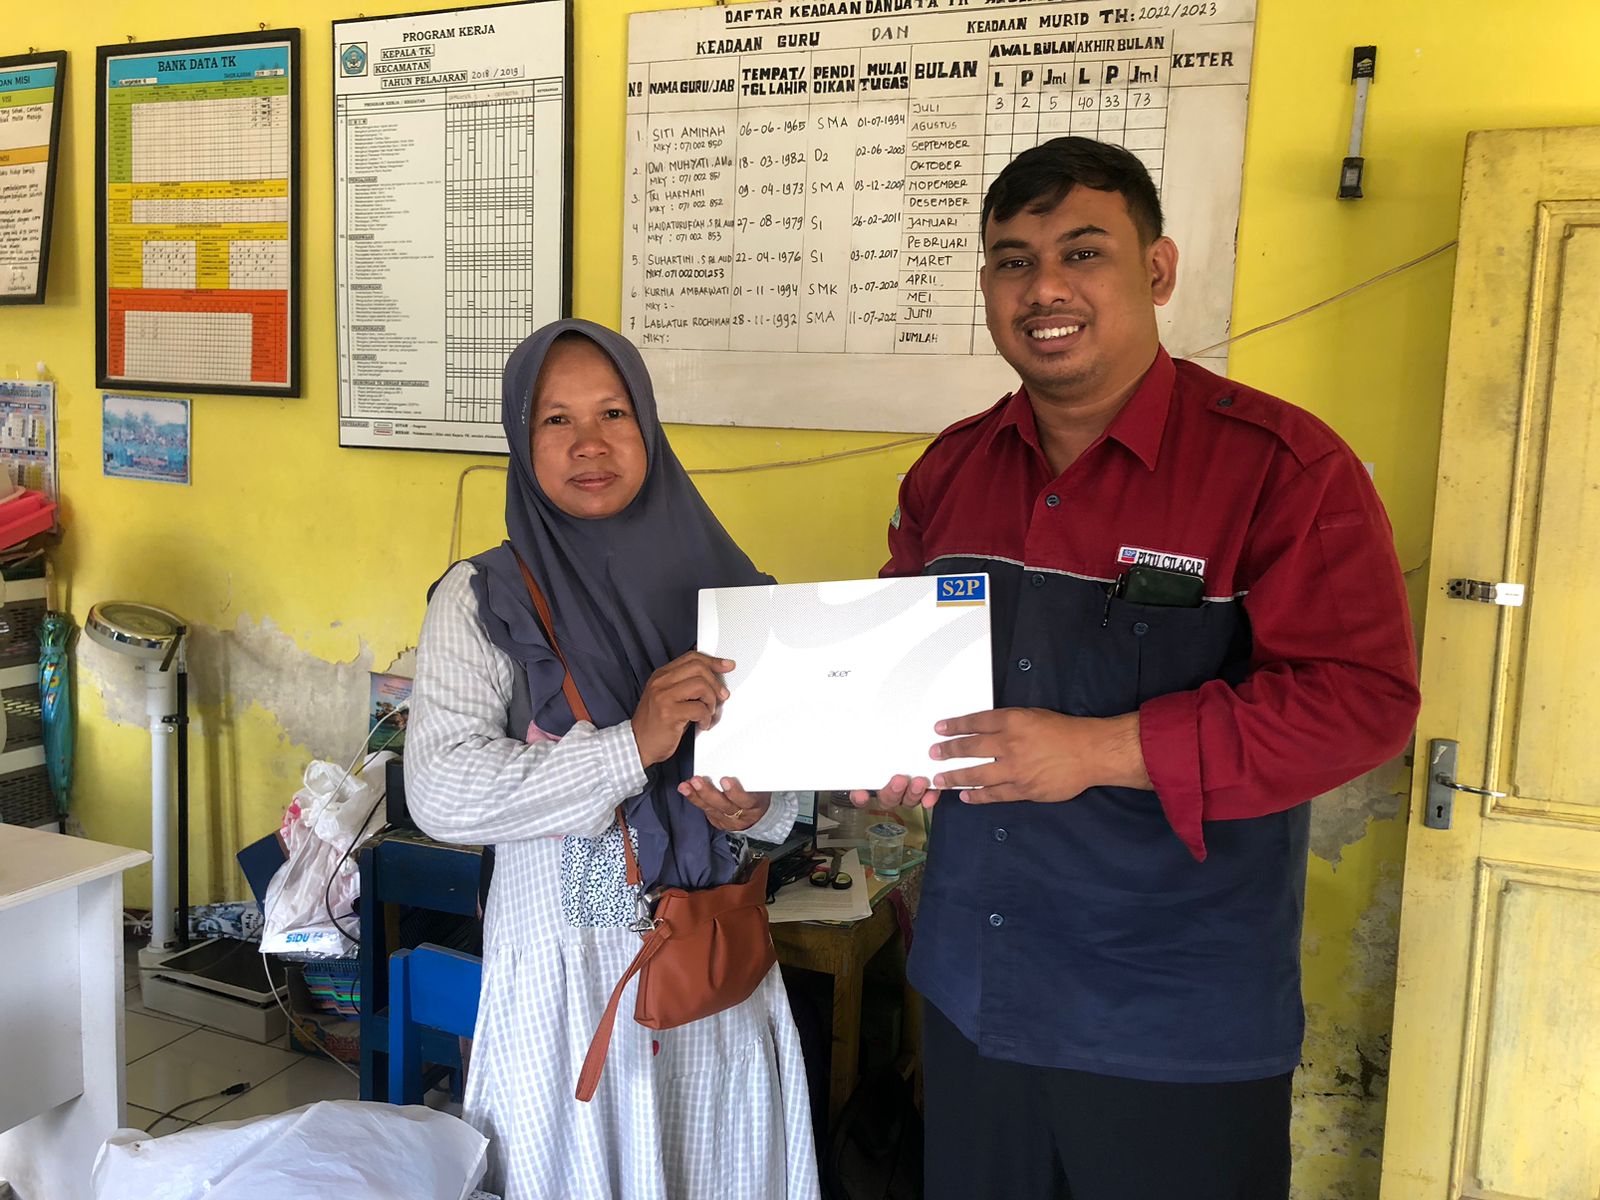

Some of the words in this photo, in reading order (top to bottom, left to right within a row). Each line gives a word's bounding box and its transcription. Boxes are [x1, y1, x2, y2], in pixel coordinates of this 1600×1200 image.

[725, 5, 783, 24] DAFTAR
[790, 0, 861, 19] KEADAAN
[402, 28, 455, 43] PROGRAM
[459, 24, 496, 39] KERJA
[697, 36, 763, 55] KEADAAN
[777, 32, 820, 49] GURU
[872, 25, 909, 41] DAN
[967, 17, 1028, 34] KEADAAN
[1039, 13, 1089, 29] MURID
[1139, 3, 1218, 20] 2022/2023
[990, 44, 1032, 58] AWAL
[1033, 41, 1076, 56] BULAN
[1077, 39, 1115, 53] AKHIR
[1118, 36, 1165, 51] BULAN
[382, 48, 417, 60] KEPALA
[1172, 50, 1235, 70] KETER
[158, 59, 187, 72] BANK
[190, 57, 219, 70] DATA
[221, 55, 237, 68] TK
[375, 62, 430, 74] KECAMATAN
[867, 61, 907, 76] MULAI
[914, 60, 979, 80] BULAN
[814, 64, 855, 80] PENDI
[994, 71, 1004, 87] L
[1021, 69, 1034, 87] P
[1079, 67, 1091, 85] L
[1105, 65, 1119, 84] P
[15, 75, 31, 85] MISI
[383, 77, 412, 89] TAHUN
[415, 73, 467, 87] PELAJARAN
[814, 80, 855, 94] DIKAN
[860, 75, 909, 92] TUGAS
[649, 81, 678, 95] NAMA
[742, 83, 767, 97] TGL
[768, 81, 808, 96] LAHIR
[912, 103, 940, 114] JULI
[995, 96, 1005, 111] 3
[1021, 96, 1032, 109] 2
[1049, 95, 1059, 110] 5
[1078, 95, 1094, 110] 40
[1104, 94, 1121, 109] 33
[1132, 92, 1151, 108] 73
[817, 116, 849, 130] SMA
[911, 120, 958, 132] AGUSTUS
[652, 128, 674, 142] SITI
[681, 125, 725, 139] AMINAH
[911, 139, 971, 151] SEPTEMBER
[910, 160, 962, 172] OKTOBER
[811, 180, 845, 194] SMA
[909, 178, 968, 191] NOPEMBER
[910, 197, 971, 208] DESEMBER
[906, 217, 959, 230] JANUARI
[908, 236, 968, 249] PEBRUARI
[907, 255, 953, 268] MARET
[644, 286, 675, 298] KURNIA
[680, 285, 730, 297] AMBARWATI
[808, 283, 838, 296] SMK
[906, 292, 932, 304] MEI
[806, 310, 836, 325] SMA
[904, 307, 932, 321] JUNI
[899, 331, 939, 344] JUMLAH
[942, 578, 981, 598] S2P
[827, 669, 852, 678] acer
